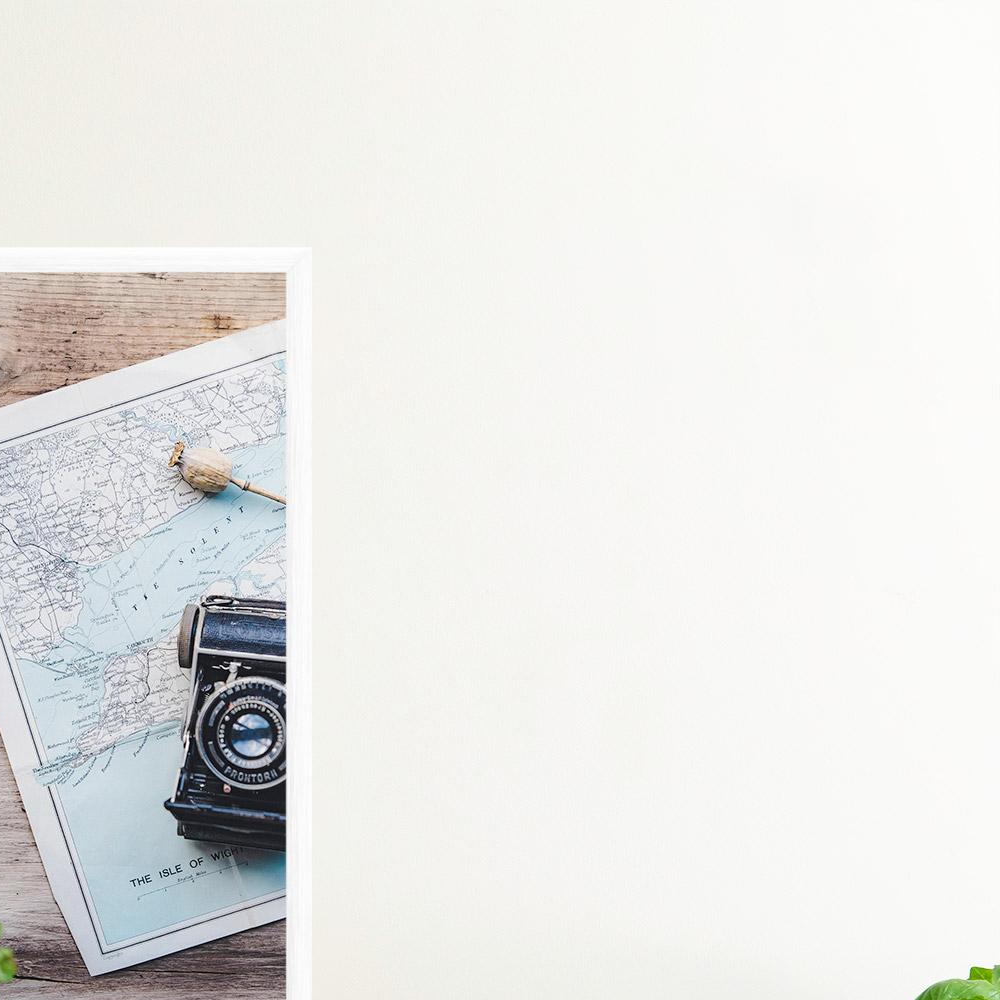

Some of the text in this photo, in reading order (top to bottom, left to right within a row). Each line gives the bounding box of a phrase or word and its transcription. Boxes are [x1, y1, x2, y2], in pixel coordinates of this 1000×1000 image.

[129, 874, 153, 888] THE
[158, 863, 183, 879] ISLE
[189, 856, 204, 869] OF
